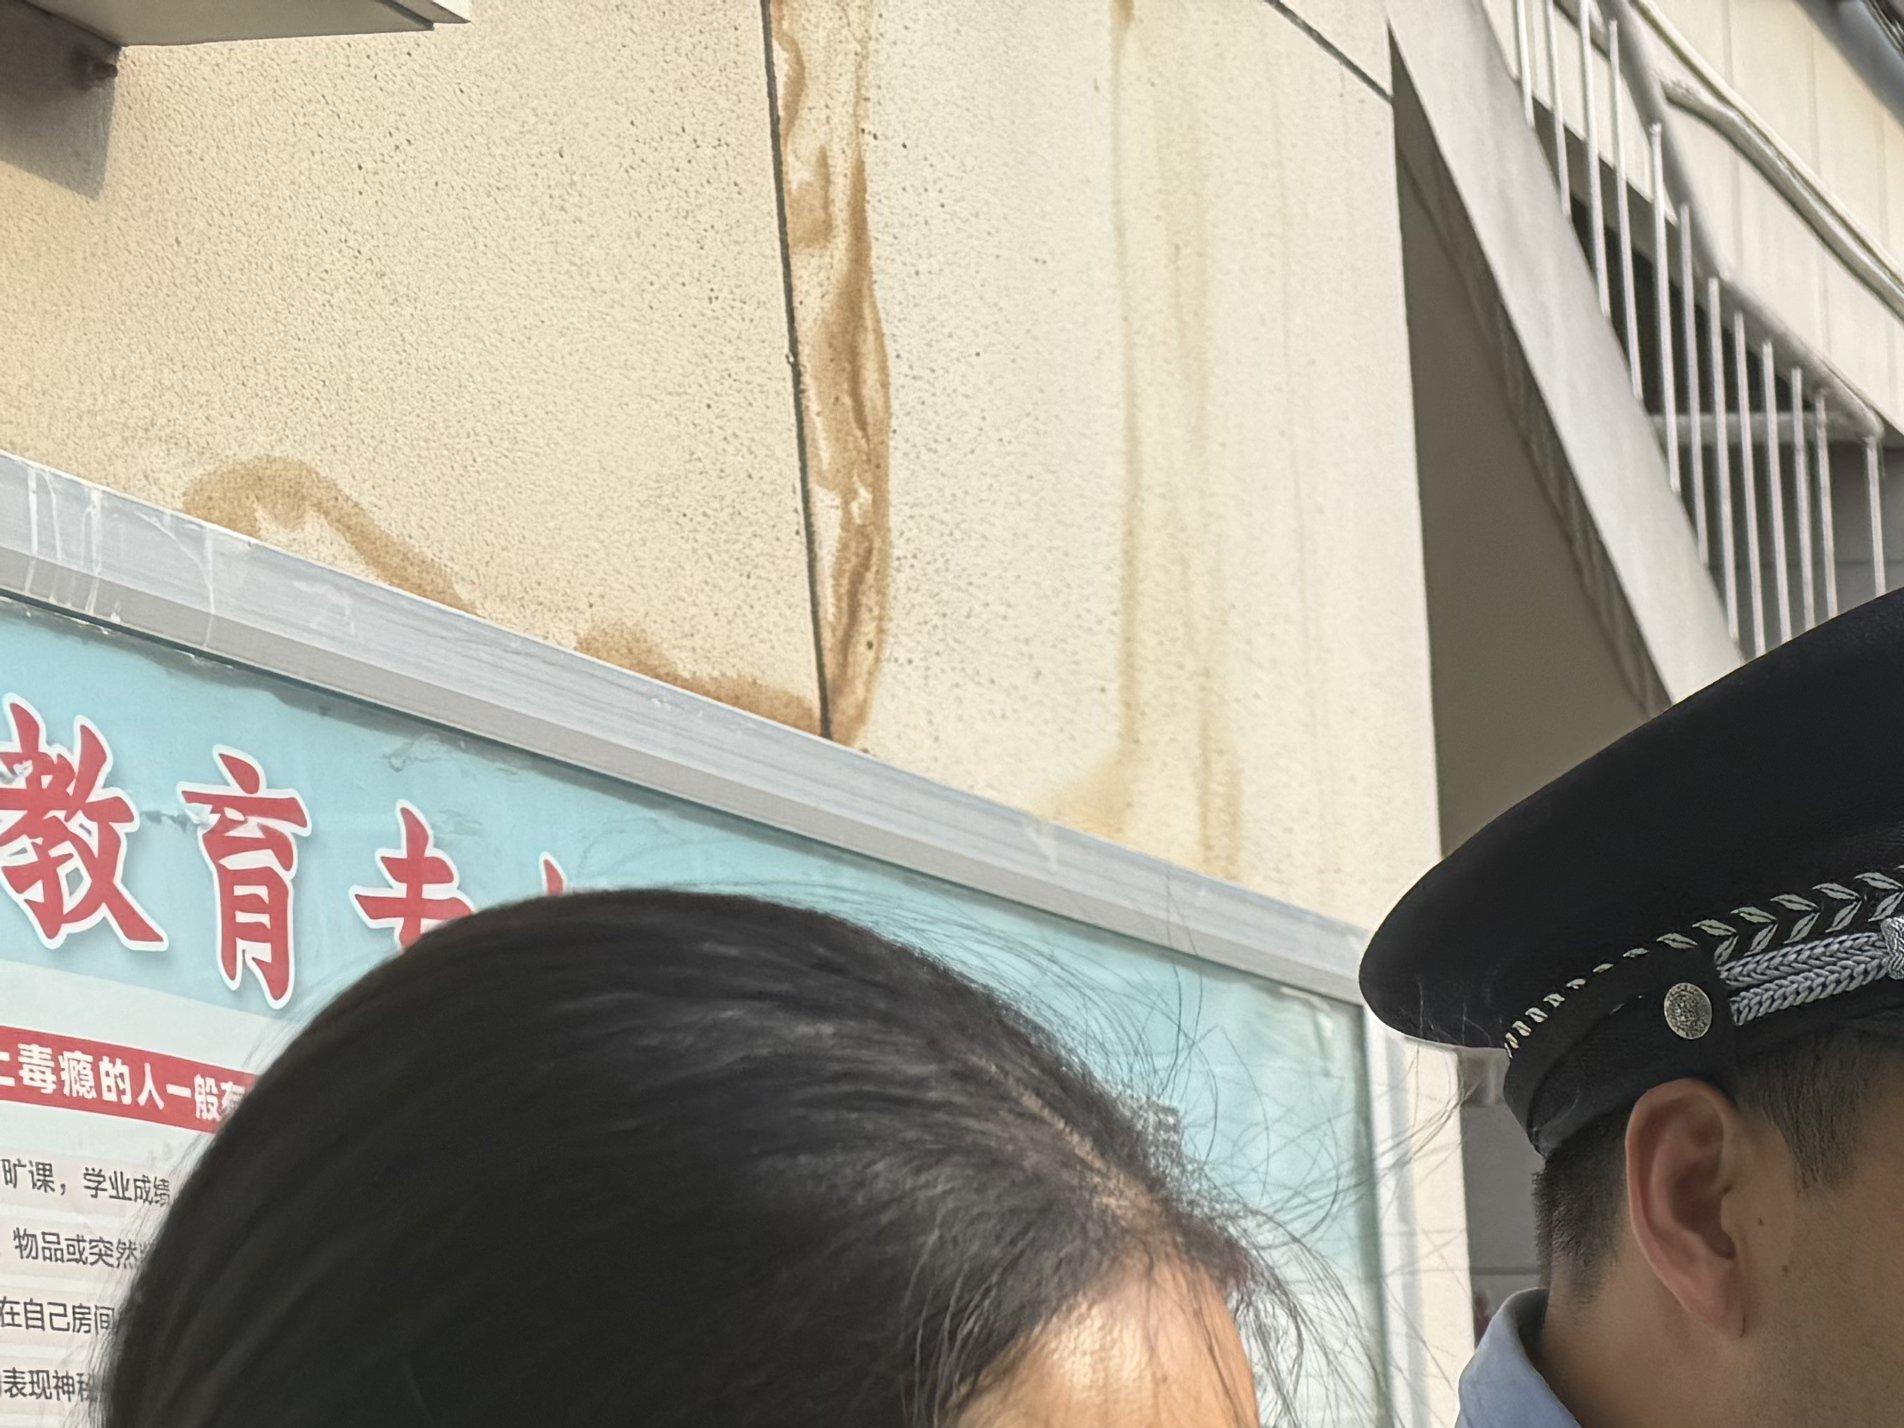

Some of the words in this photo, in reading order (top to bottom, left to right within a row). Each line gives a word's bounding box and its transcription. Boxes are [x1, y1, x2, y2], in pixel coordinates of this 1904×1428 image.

[13, 1227, 149, 1269] 物品或突然
